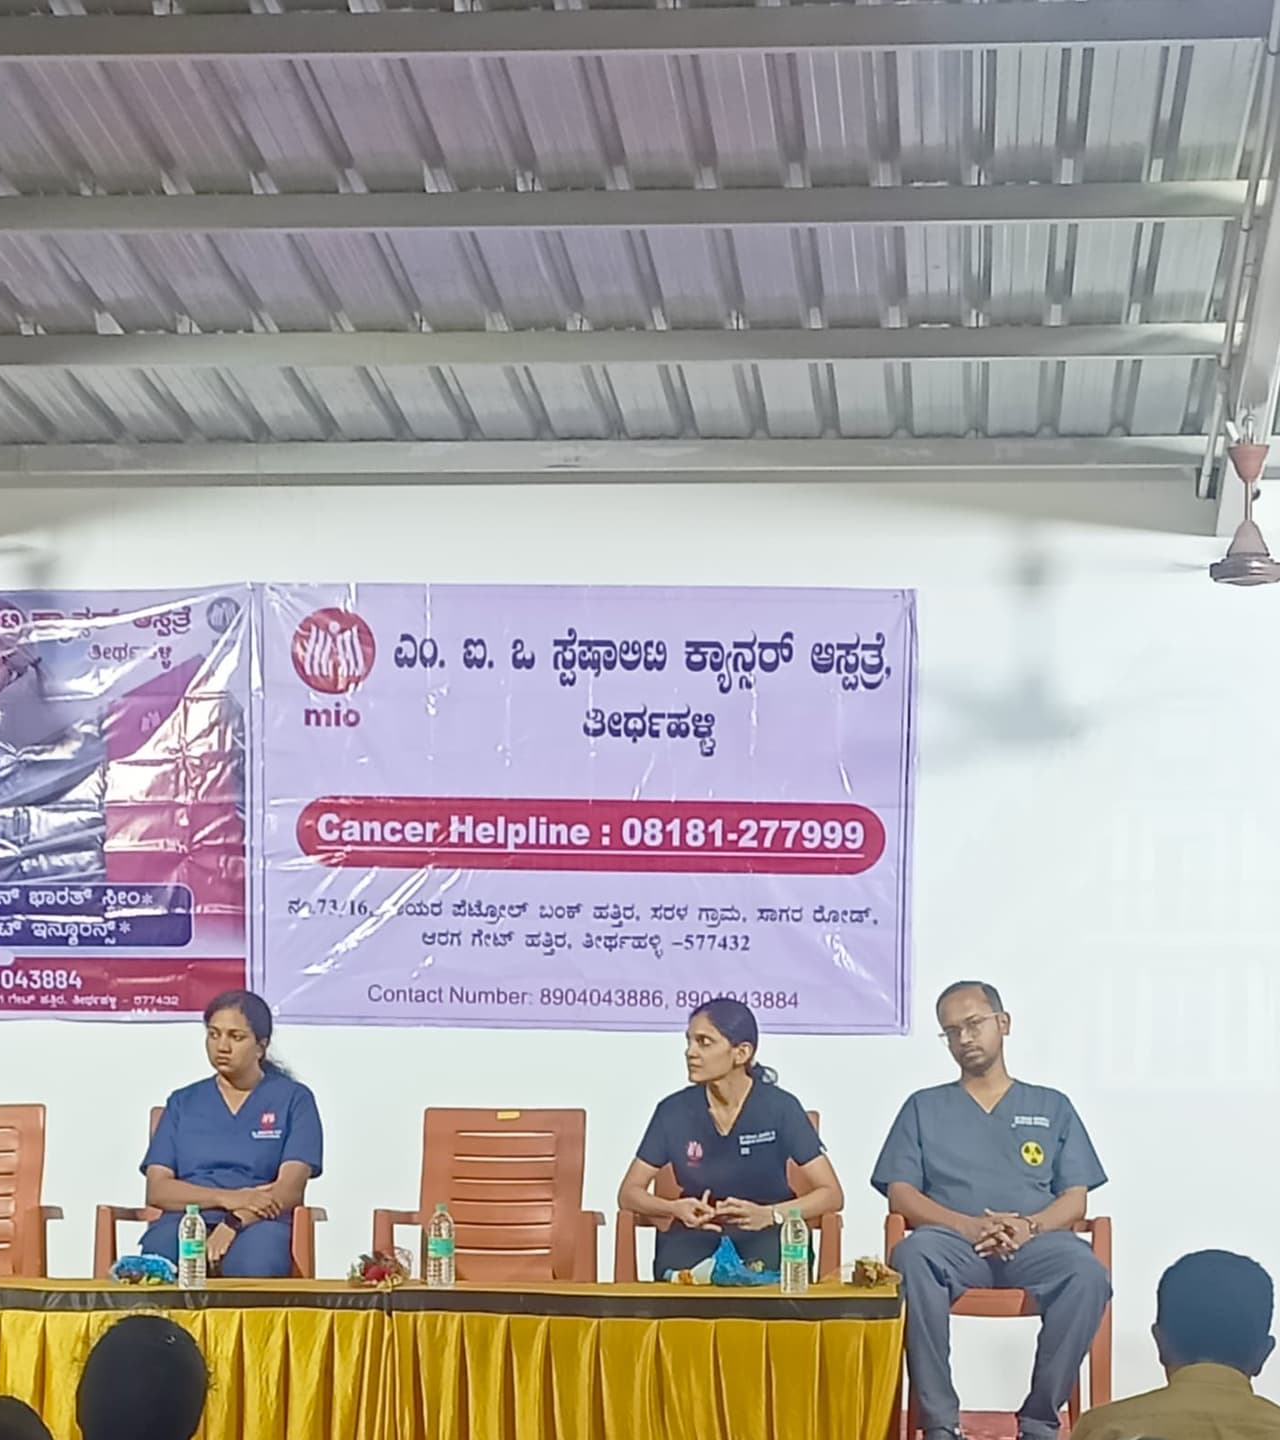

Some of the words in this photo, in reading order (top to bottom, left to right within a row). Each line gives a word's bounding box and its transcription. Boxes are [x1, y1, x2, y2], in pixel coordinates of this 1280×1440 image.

[512, 639, 535, 670] ಒ
[553, 627, 667, 687] ಸ್ಪೆಷಾಲಿಟಿ
[685, 630, 794, 694] ಕ್ಯಾನ್ಸರ್
[304, 702, 360, 727] mio
[583, 704, 716, 757] ತೀರ್ಥಹಳ್ಳಿ
[318, 813, 440, 842] Cancer
[450, 815, 590, 850] Helpline
[622, 818, 864, 849] 08181-277999
[133, 996, 179, 1005] 577432
[368, 984, 443, 1003] Contact
[450, 986, 533, 1005] Number:
[540, 988, 669, 1009] 8904043886,
[676, 990, 799, 1009] 89043884
